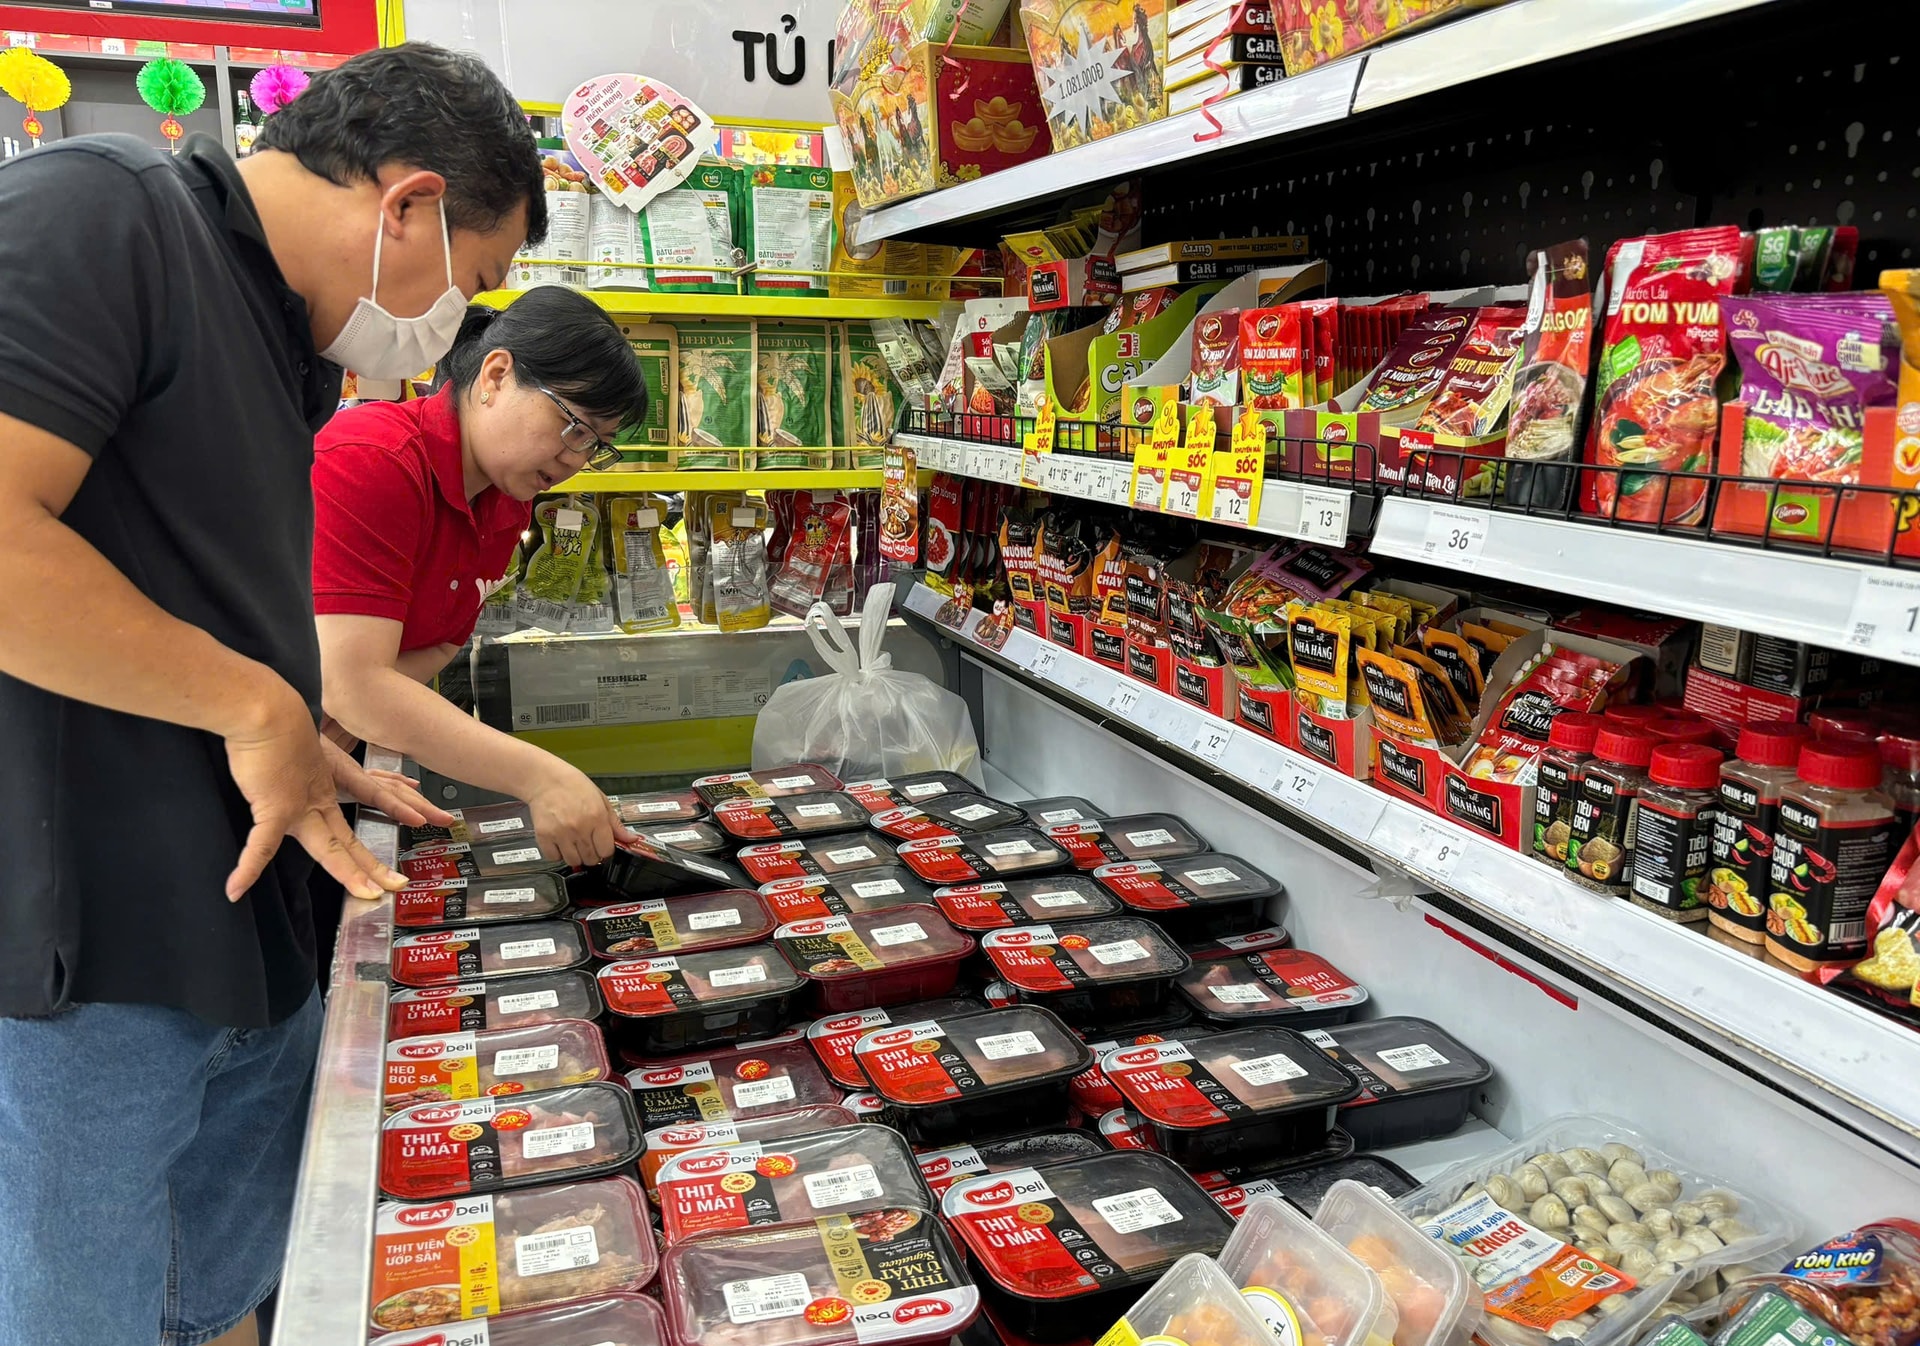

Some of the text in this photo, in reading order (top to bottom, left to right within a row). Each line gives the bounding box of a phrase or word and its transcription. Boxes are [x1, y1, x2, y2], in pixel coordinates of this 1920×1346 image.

[1246, 8, 1274, 25] CàR
[732, 13, 806, 86] TỦ
[1255, 66, 1284, 82] CàR
[1764, 230, 1785, 250] SG
[1621, 302, 1719, 325] TOM YUM
[680, 336, 735, 346] HEER TALK
[759, 338, 810, 348] HEER TALK
[1322, 427, 1349, 443] Barona
[1187, 450, 1207, 468] SỐC
[1235, 455, 1257, 474] SỐC
[1379, 464, 1399, 480] Thơm
[1181, 491, 1190, 507] 12
[1229, 499, 1240, 514] 12
[1319, 510, 1332, 526] 13
[1448, 528, 1469, 550] 36
[1002, 546, 1033, 558] NƯỚNG
[1296, 624, 1315, 634] CHIN-SU
[1294, 640, 1332, 660] NHÀ HÀNG
[597, 674, 648, 684] LIEBHERR
[1121, 693, 1130, 704] 11
[1368, 681, 1404, 706] NHÀ HÀNG
[1523, 693, 1550, 708] CHIN-SU
[1510, 708, 1533, 724] NHÀ
[1208, 735, 1221, 749] 12
[1499, 735, 1539, 754] THỊT KHO
[1382, 755, 1417, 782] NHÀ HÀNG
[1542, 765, 1567, 781] CHIN-SU
[1292, 776, 1306, 792] 12
[1450, 778, 1466, 792] CHIN-SU
[1585, 777, 1614, 795] CHIN-SU
[1537, 786, 1551, 802] TIÊU
[1721, 783, 1756, 805] CHIN-SU
[1449, 792, 1491, 820] NHÀ HÀNG
[1536, 802, 1550, 817] ĐEN
[1576, 799, 1593, 818] TIÊU
[1727, 816, 1742, 830] TÔM
[1781, 804, 1817, 828] CHIN-SU
[1573, 817, 1590, 833] ĐEN
[1714, 823, 1736, 844] CHUA
[1689, 834, 1708, 851] TIÊU
[1712, 839, 1730, 859] CAY
[1787, 840, 1802, 855] TÔM
[1438, 846, 1449, 861] 8
[1686, 852, 1707, 867] ĐEN
[1772, 846, 1795, 869] CHUA
[1771, 864, 1789, 884] CAY
[420, 933, 451, 942] MEAT
[421, 988, 453, 996] MEAT
[878, 1027, 939, 1044] MEAT Deli
[405, 1043, 473, 1055] MEAT Deli
[1124, 1047, 1186, 1064] MEAT Deli
[389, 1065, 416, 1074] HEO
[649, 1067, 710, 1082] MEAT Deli
[389, 1075, 416, 1085] BỌC
[418, 1105, 492, 1120] MEAT Deli
[402, 1132, 442, 1145] THỊT
[667, 1129, 733, 1142] MEAT Deli
[686, 1153, 757, 1170] MEAT Deli
[675, 1184, 715, 1199] THỊT
[972, 1180, 1046, 1204] MEAT Deli
[404, 1203, 490, 1222] MEAT Deli
[975, 1216, 1018, 1233] THỊT
[1449, 1225, 1484, 1245] Nghêu
[1483, 1210, 1507, 1232] sạch
[386, 1238, 445, 1255] THỊT VIÊN
[1463, 1221, 1528, 1258] LENGER
[878, 1251, 935, 1267] Signature
[1794, 1249, 1876, 1269] TÔM KHÔ
[901, 1273, 948, 1291] THỊT
[855, 1302, 943, 1323] MEAT Deli
